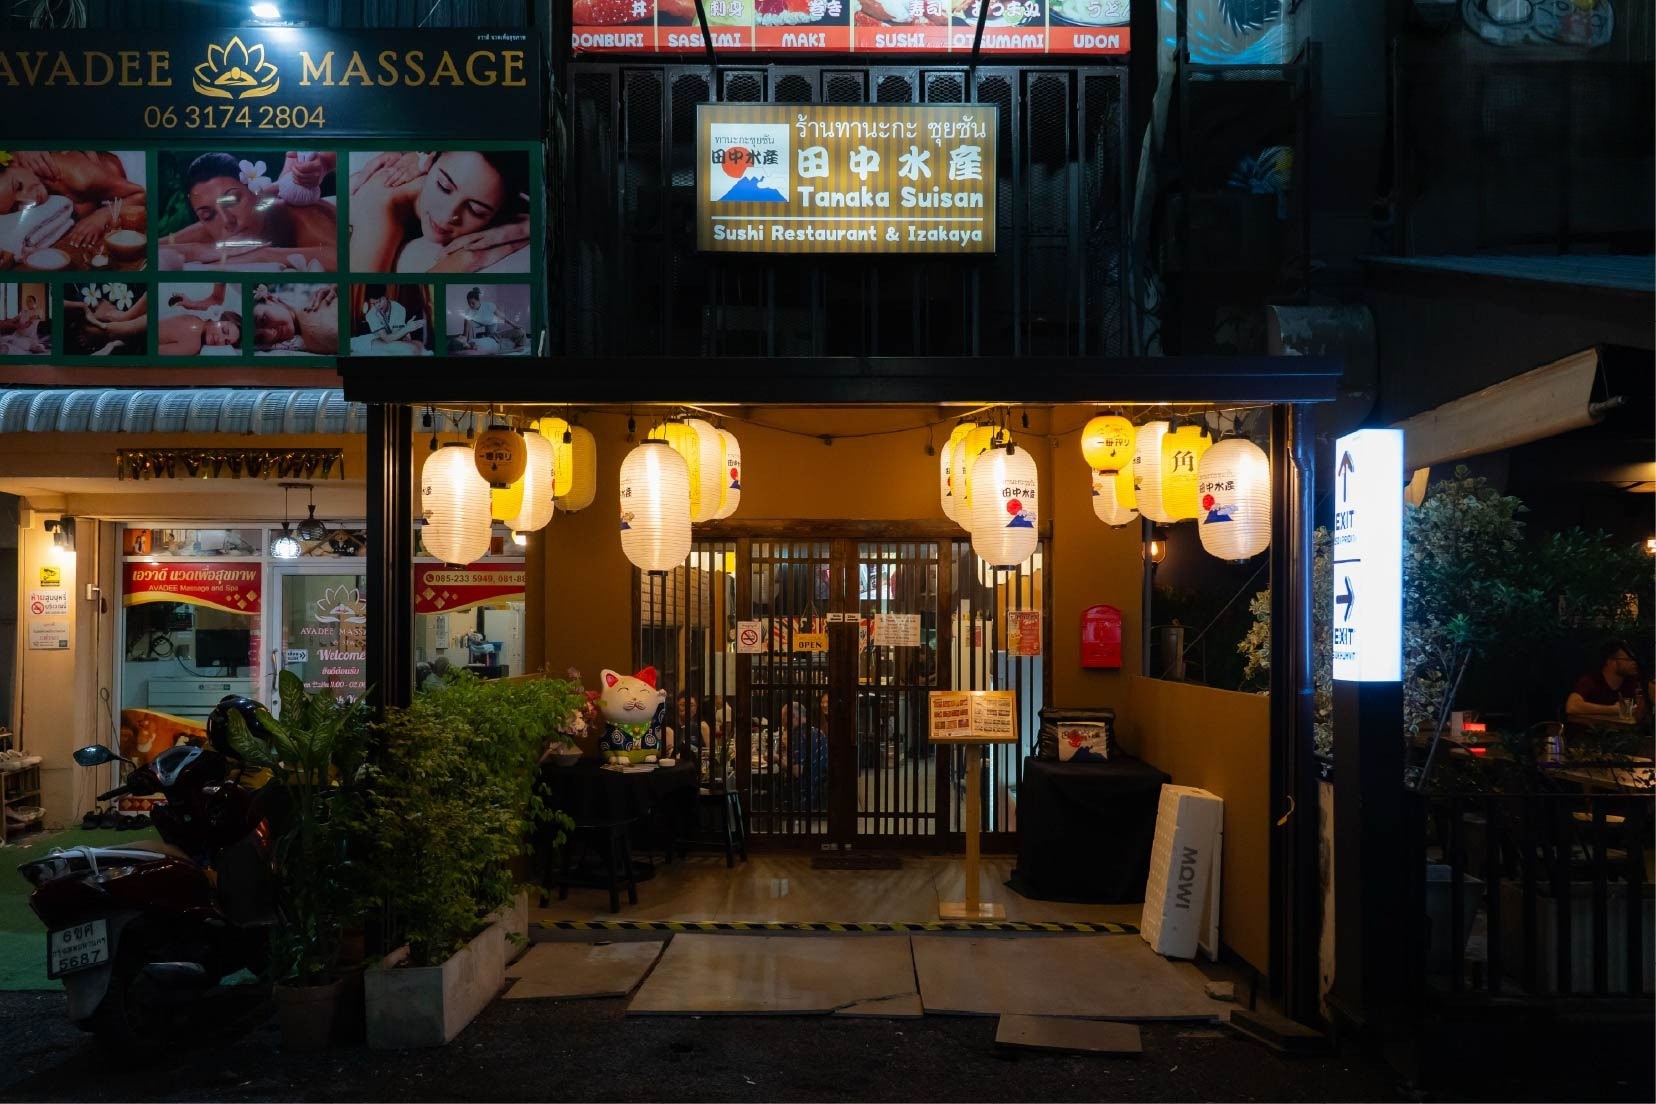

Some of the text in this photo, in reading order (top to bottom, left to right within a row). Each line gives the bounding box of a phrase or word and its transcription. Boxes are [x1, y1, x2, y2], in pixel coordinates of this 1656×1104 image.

[572, 33, 644, 47] DONBURI
[781, 33, 825, 48] MAKI
[875, 33, 925, 48] SUSHI
[1073, 34, 1120, 49] UDON
[0, 50, 526, 87] AVADEE MASSAGE
[144, 105, 326, 129] 06 3174 2804
[795, 114, 987, 147] ร้านทานะกะ ซุยซัน
[711, 148, 780, 166] 田中水産
[797, 145, 984, 181] 田中水産
[797, 186, 984, 208] Tanaka Suisan
[713, 224, 982, 247] Sushi Restaurant & Izakaya
[1335, 510, 1355, 531] EXIT
[170, 566, 257, 584] นวดเพื่อสุขภาพ
[435, 574, 469, 583] 085-233
[180, 585, 209, 593] Massage
[225, 585, 239, 593] Spa
[798, 641, 823, 649] OPEN
[1334, 628, 1354, 645] EXIT
[317, 649, 366, 661] Welcome
[58, 949, 101, 971] 5687
